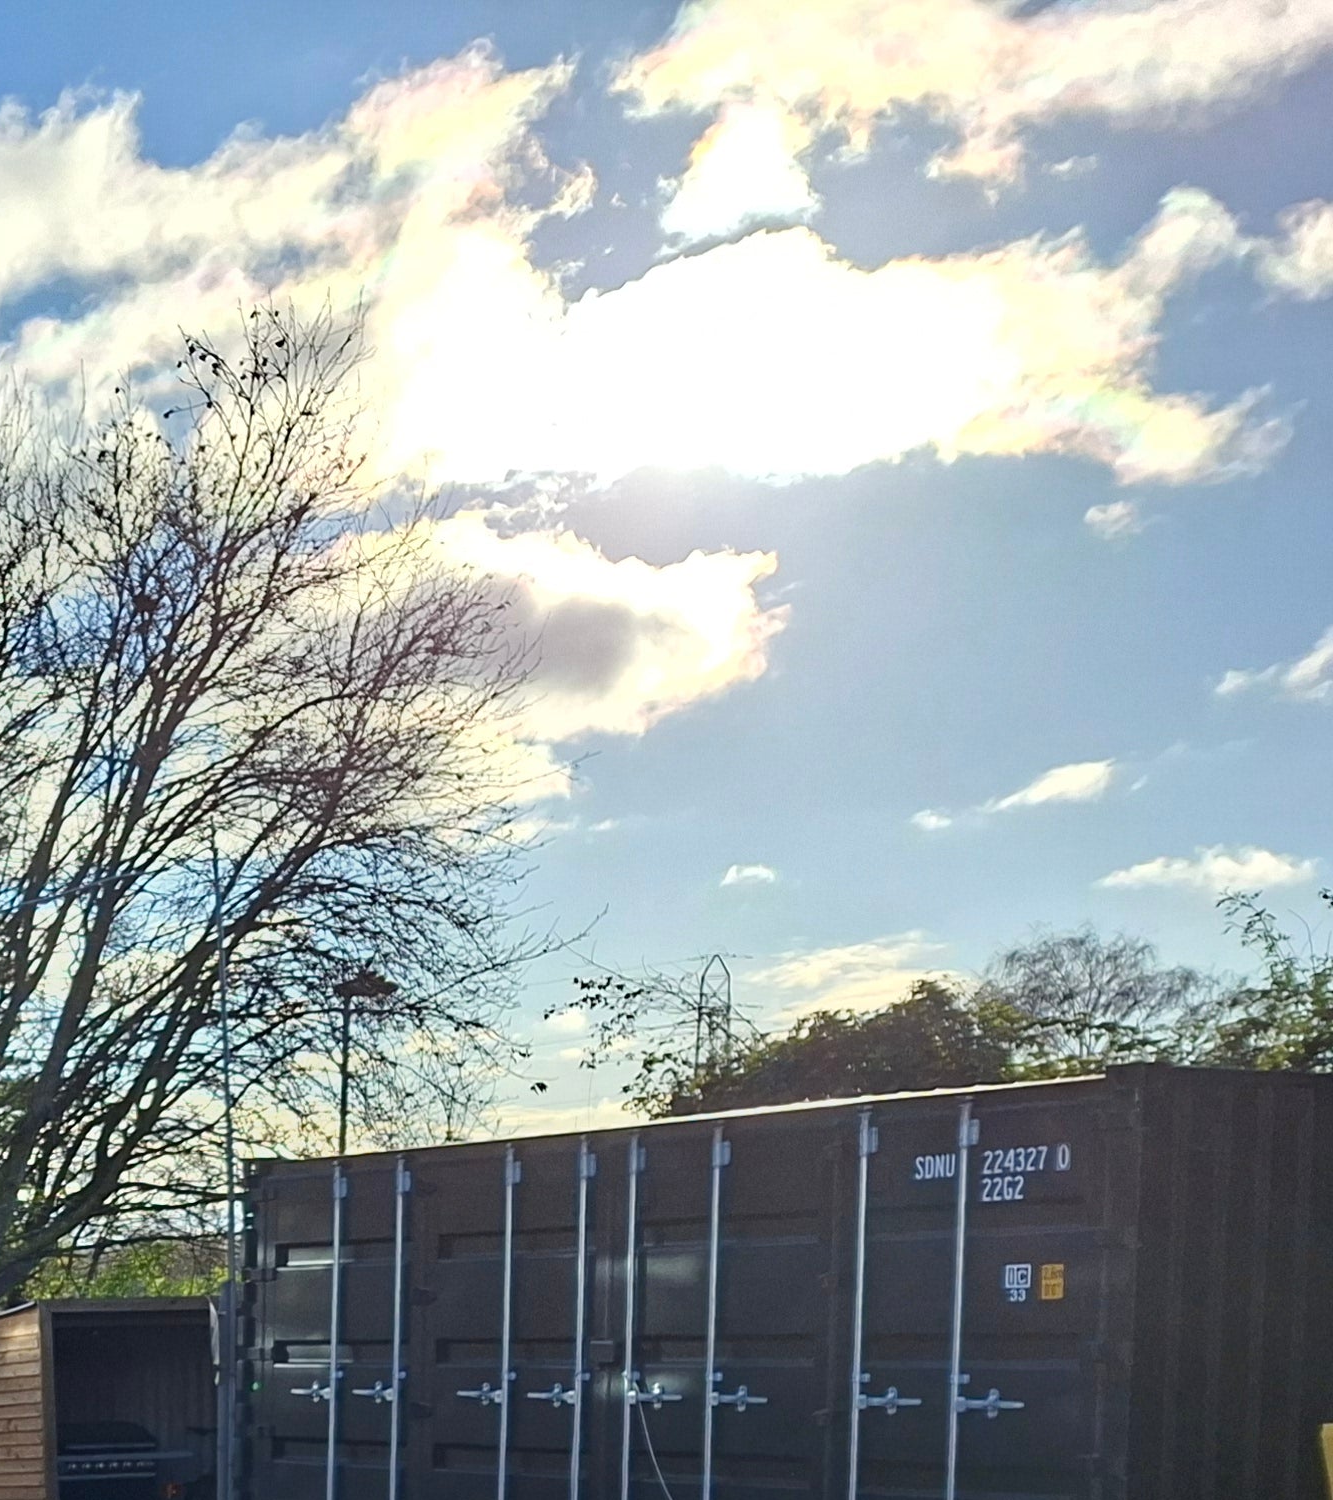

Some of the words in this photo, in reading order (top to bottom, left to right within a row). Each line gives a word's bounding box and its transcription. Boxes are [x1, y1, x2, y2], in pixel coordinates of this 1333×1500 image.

[914, 1153, 956, 1180] SDNU
[982, 1145, 1048, 1175] 224327
[1057, 1143, 1070, 1169] 0
[981, 1176, 1024, 1202] 22G2
